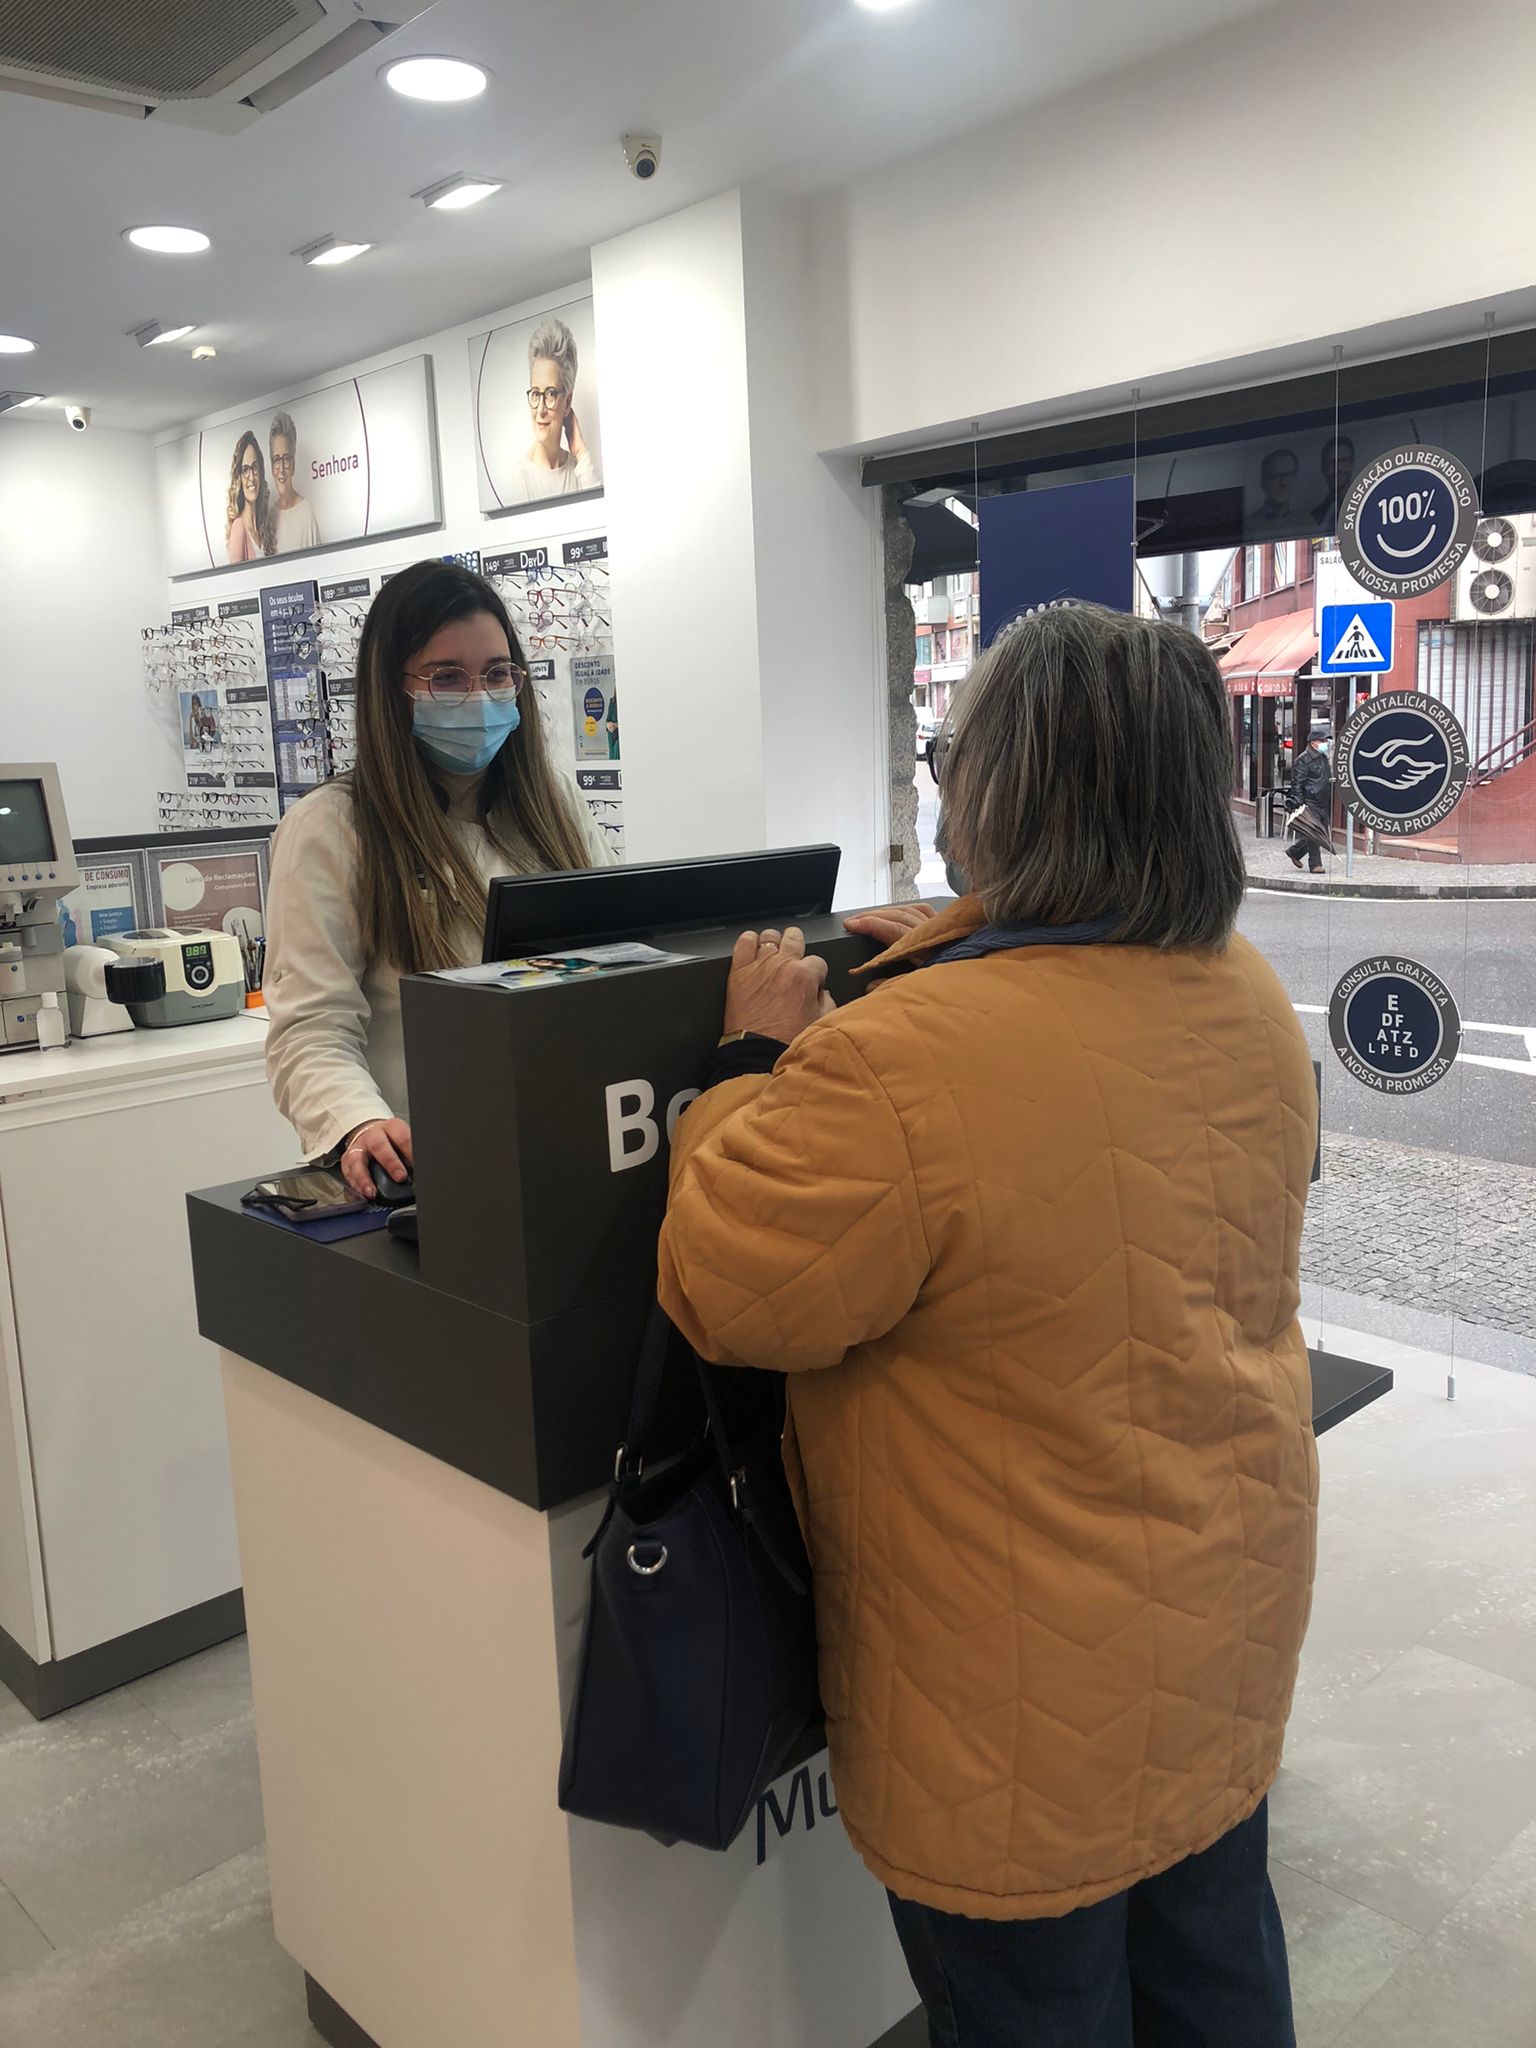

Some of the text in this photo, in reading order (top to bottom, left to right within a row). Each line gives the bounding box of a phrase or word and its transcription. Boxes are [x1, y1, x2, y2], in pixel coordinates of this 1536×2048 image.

[311, 454, 359, 480] Senhora
[1344, 451, 1471, 530] SATISFAÇÃO OU REEMBOLSO
[1378, 489, 1436, 525] 100%
[1349, 542, 1467, 594] A NOSSA PROMESSA
[1337, 692, 1464, 788] ASSISTÊNCIA VITALÍCIA GRATUITA
[1349, 780, 1464, 832] A NOSSA PROMESSA
[84, 869, 130, 882] DE CONSUMO
[1338, 960, 1448, 1007] CONSULTA GRATUITA
[1387, 994, 1399, 1011] E
[1337, 1046, 1450, 1092] A NOSSA PROMESSA
